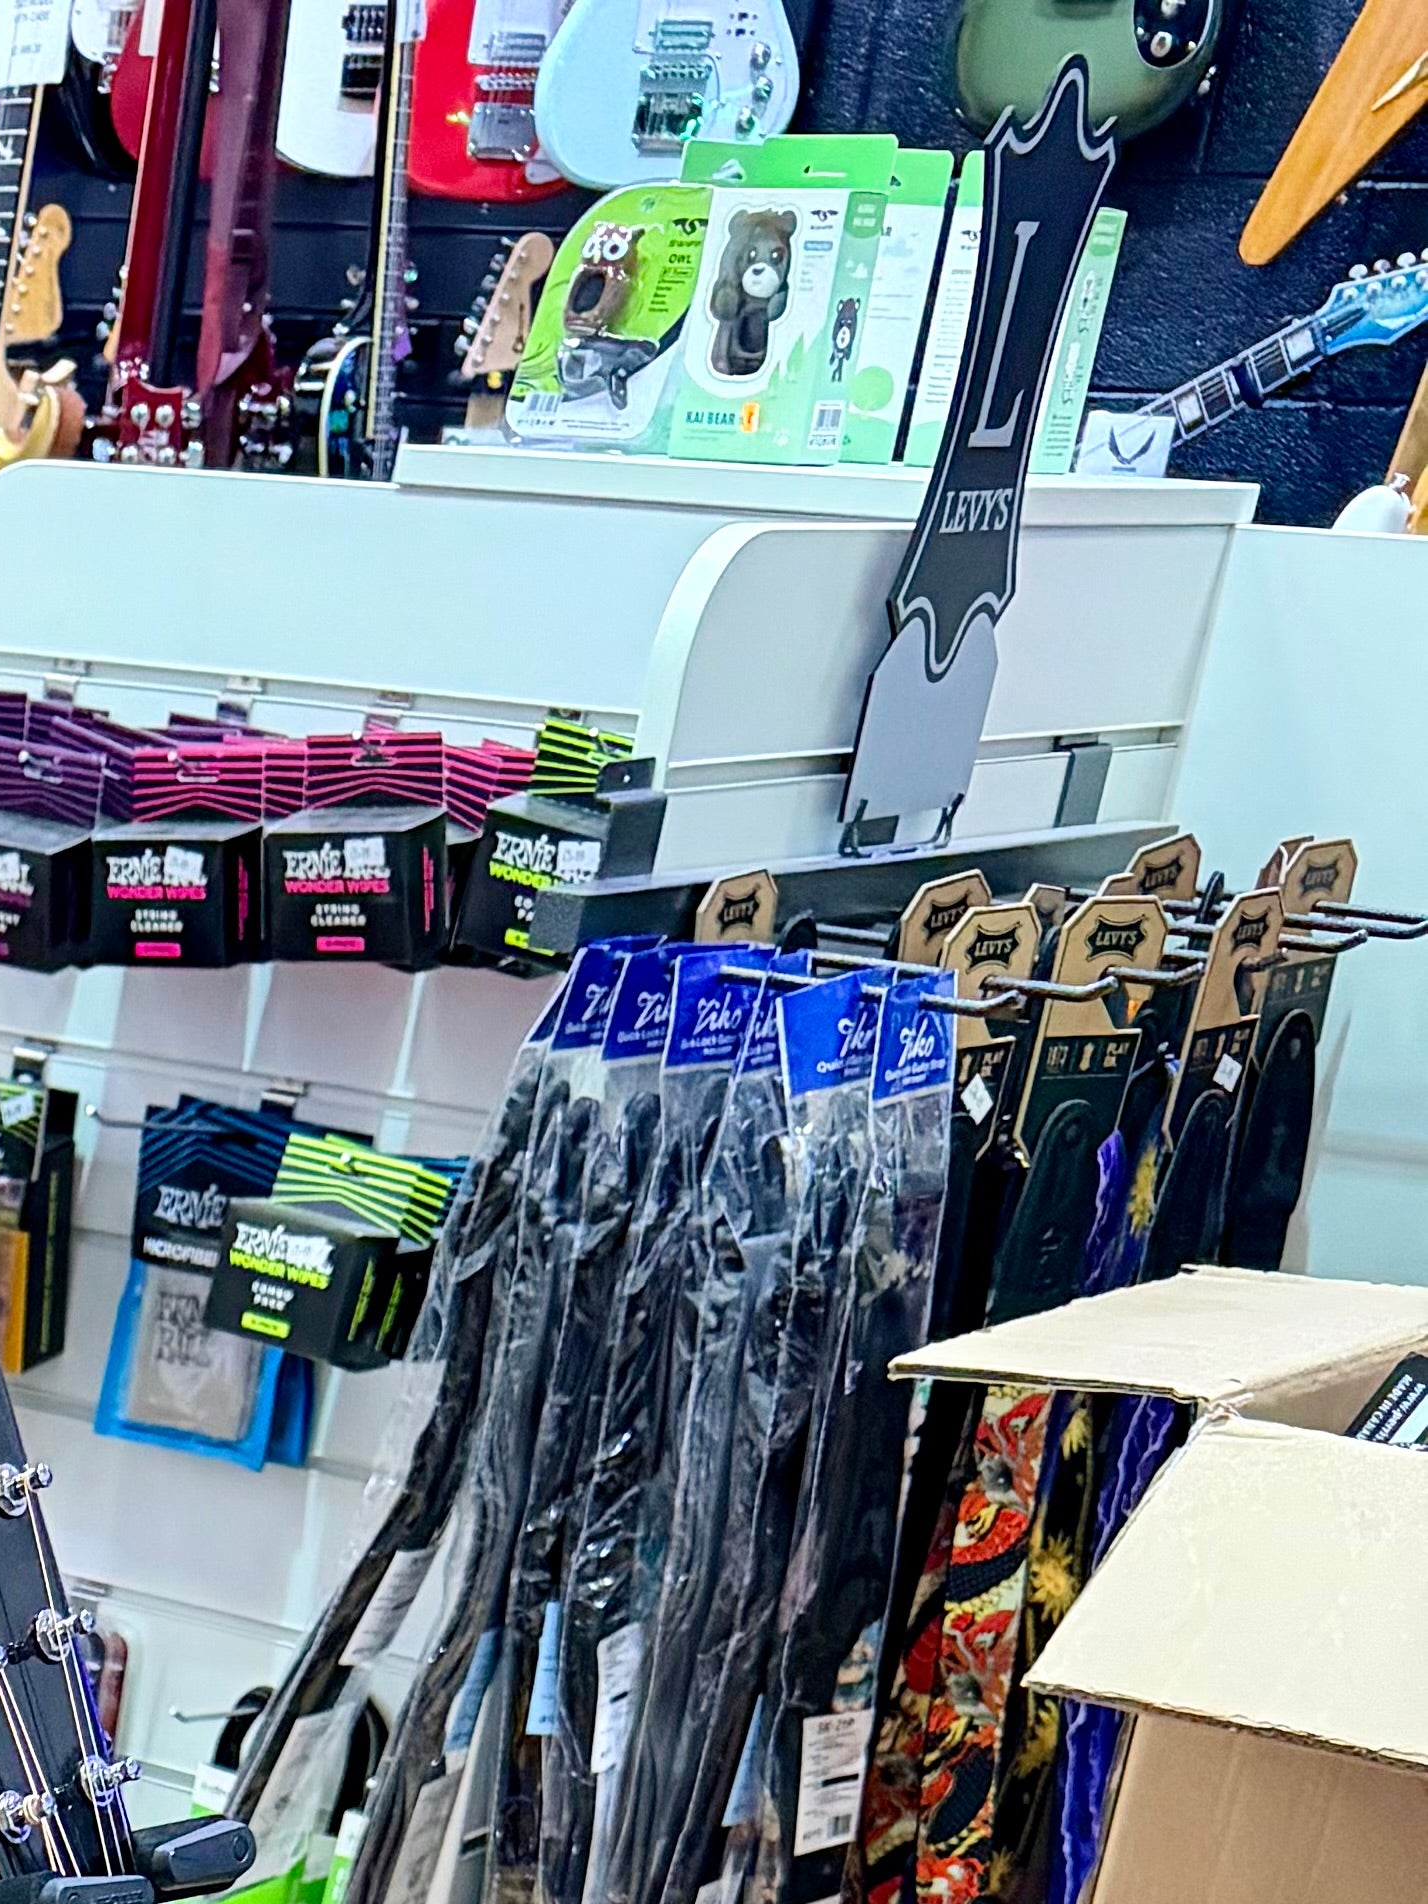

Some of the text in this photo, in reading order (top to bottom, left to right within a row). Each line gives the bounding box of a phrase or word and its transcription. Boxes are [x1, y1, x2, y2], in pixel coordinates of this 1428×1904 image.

[685, 411, 735, 426] KAI BEAR
[938, 487, 1014, 535] LEVY'S
[106, 848, 162, 886] ERNIE
[282, 842, 342, 880] ERNIE
[492, 831, 556, 873] ERNIE
[284, 879, 344, 894] WONDER
[974, 937, 1013, 960] LEVY'S
[1094, 929, 1138, 951] LEVY'S
[154, 1184, 228, 1230] ERNIE
